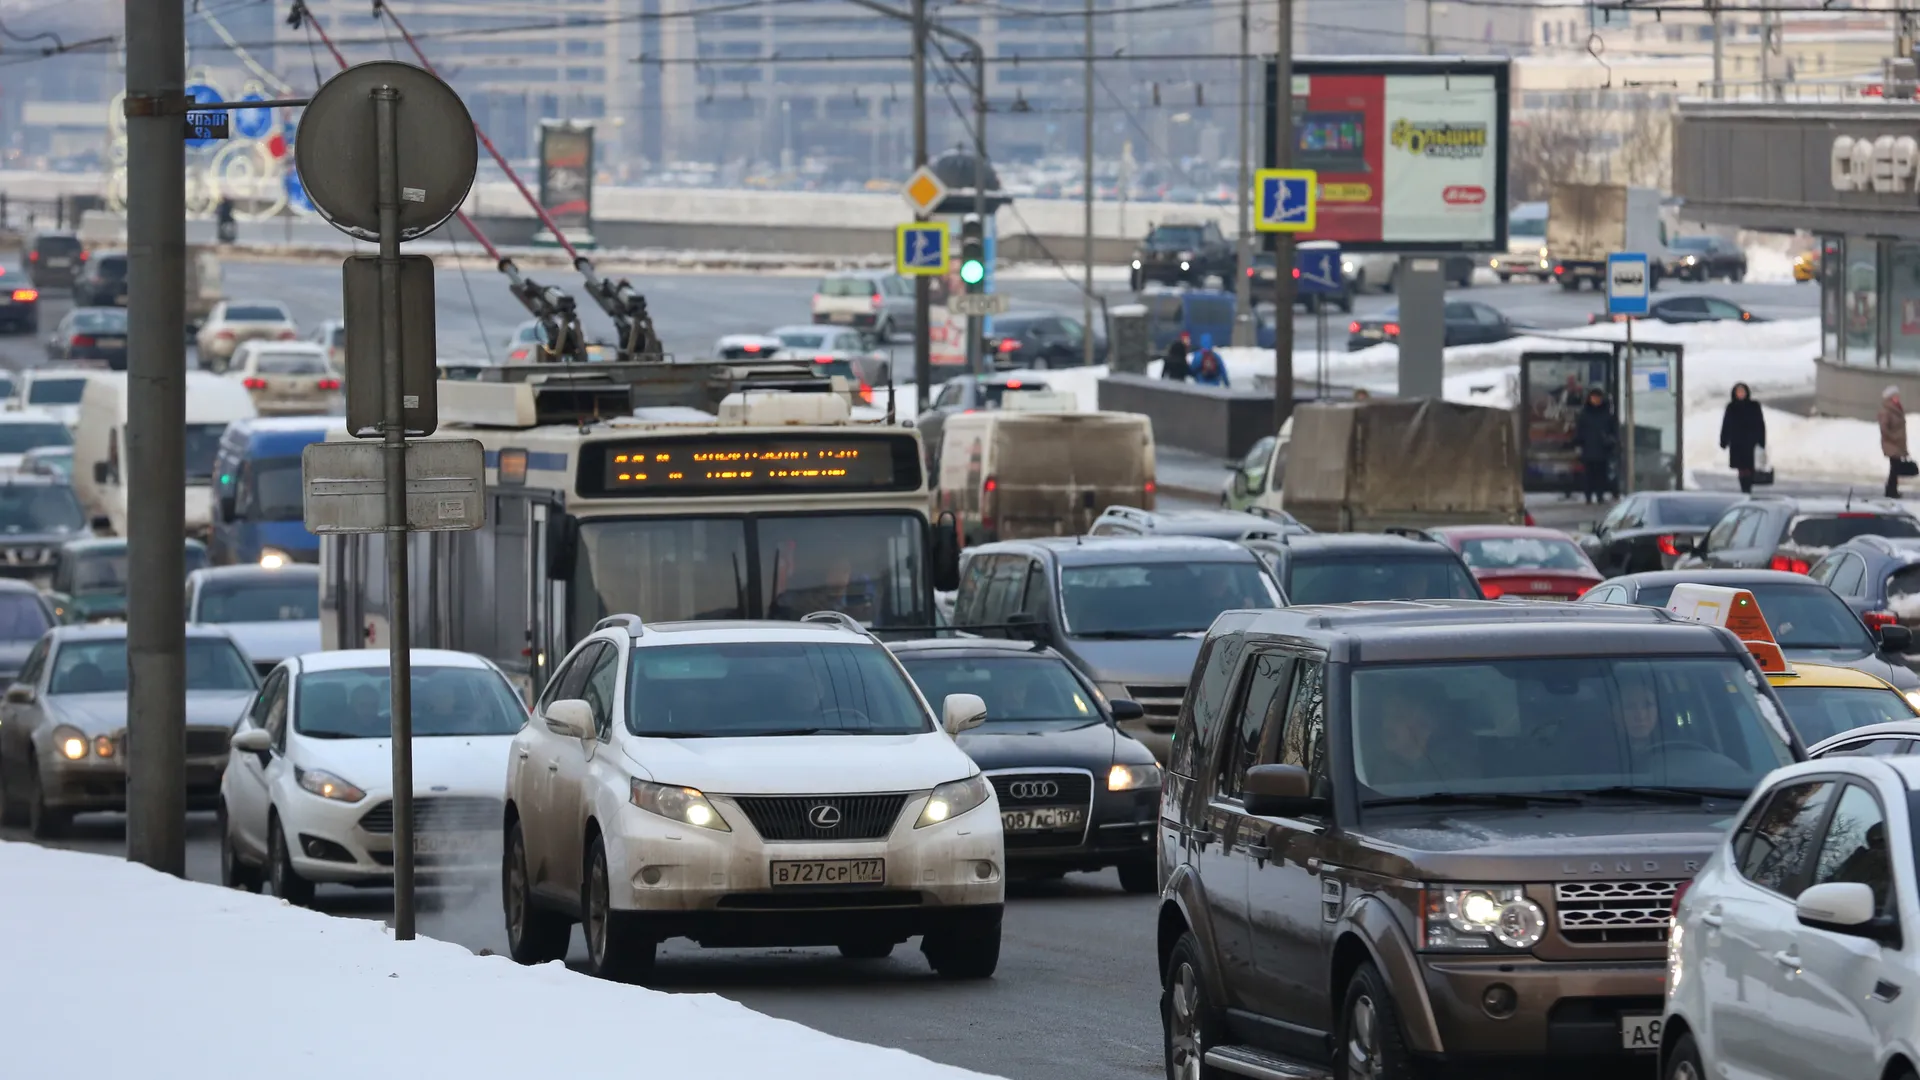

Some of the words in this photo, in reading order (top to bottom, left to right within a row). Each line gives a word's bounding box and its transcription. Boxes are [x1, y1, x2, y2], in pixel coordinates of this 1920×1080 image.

[1831, 134, 1920, 193] СФЕР
[779, 863, 848, 882] В727СР
[852, 861, 878, 875] 177
[1562, 859, 1660, 875] LAND
